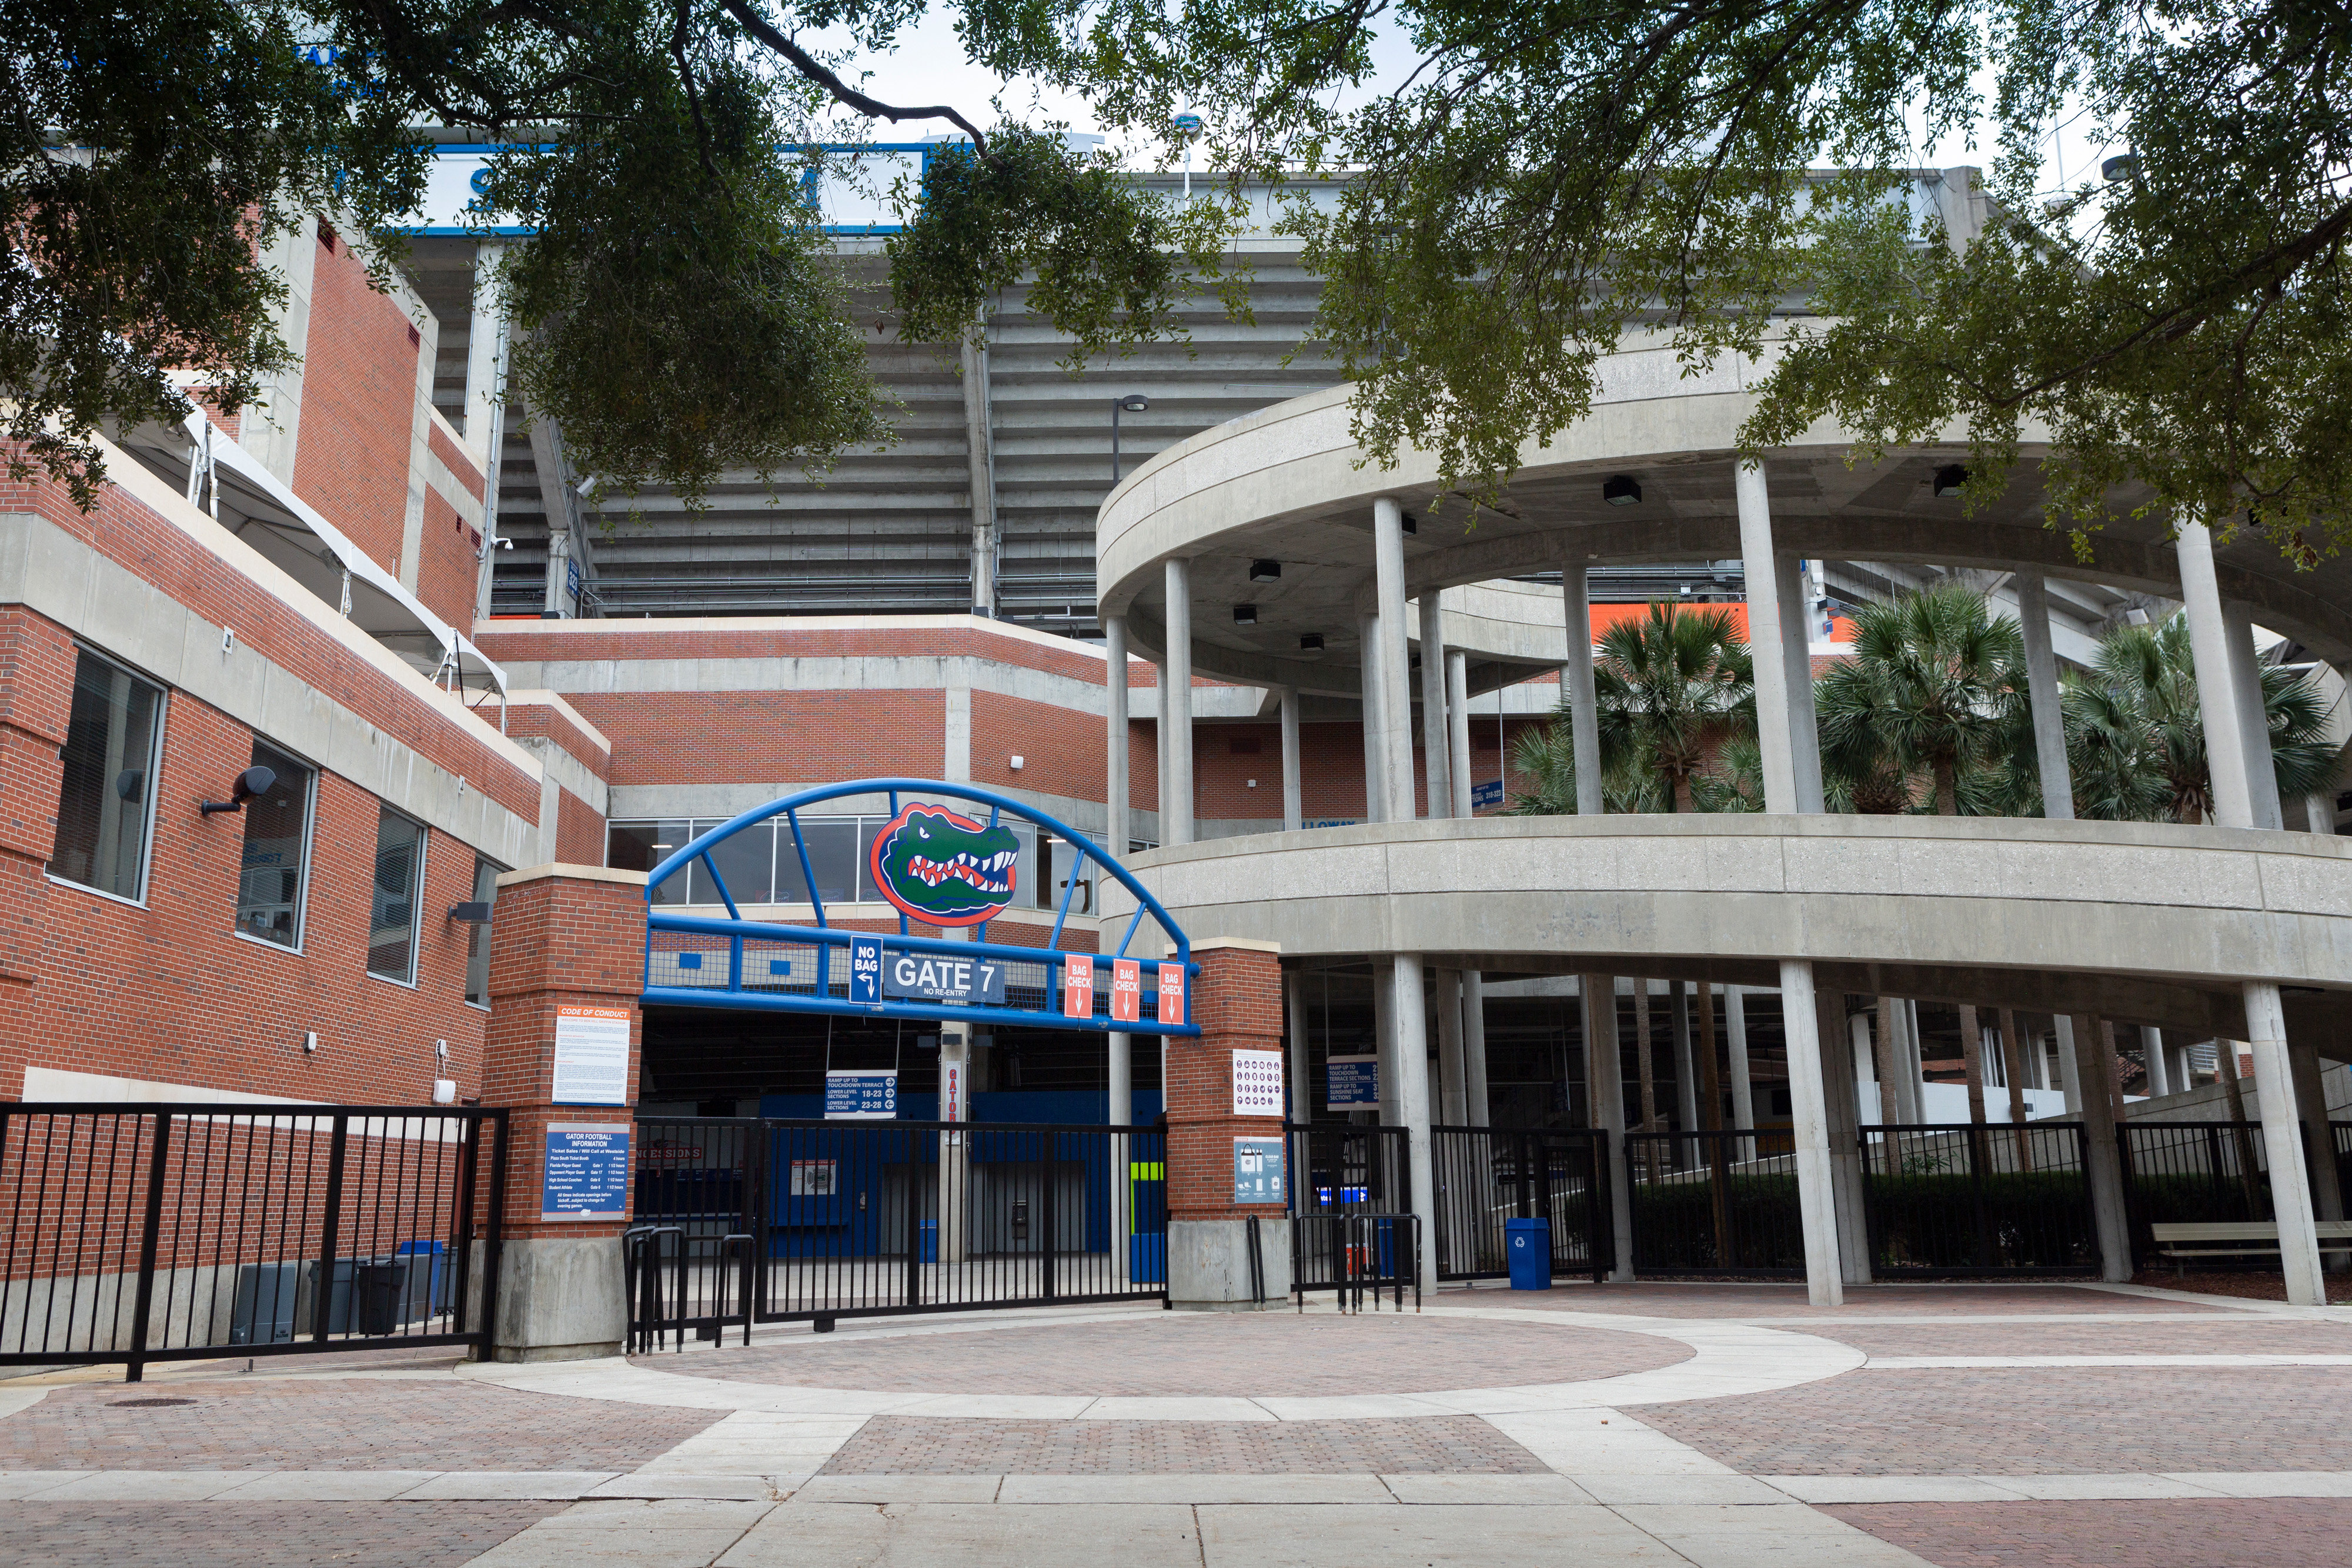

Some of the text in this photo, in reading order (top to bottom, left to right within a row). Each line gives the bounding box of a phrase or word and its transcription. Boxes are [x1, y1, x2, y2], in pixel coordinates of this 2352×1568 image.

[1486, 790, 1501, 799] 318-323
[858, 947, 875, 959] NO
[855, 959, 878, 972] BAG
[1072, 964, 1087, 976] BAG
[895, 958, 995, 992] GATE 7
[1120, 969, 1134, 980] BAG
[1165, 973, 1178, 984] BAG
[1068, 976, 1091, 988] CHECK
[1115, 980, 1138, 992] CHECK
[1161, 984, 1182, 995] CHECK
[594, 1010, 628, 1018] CONDUCT
